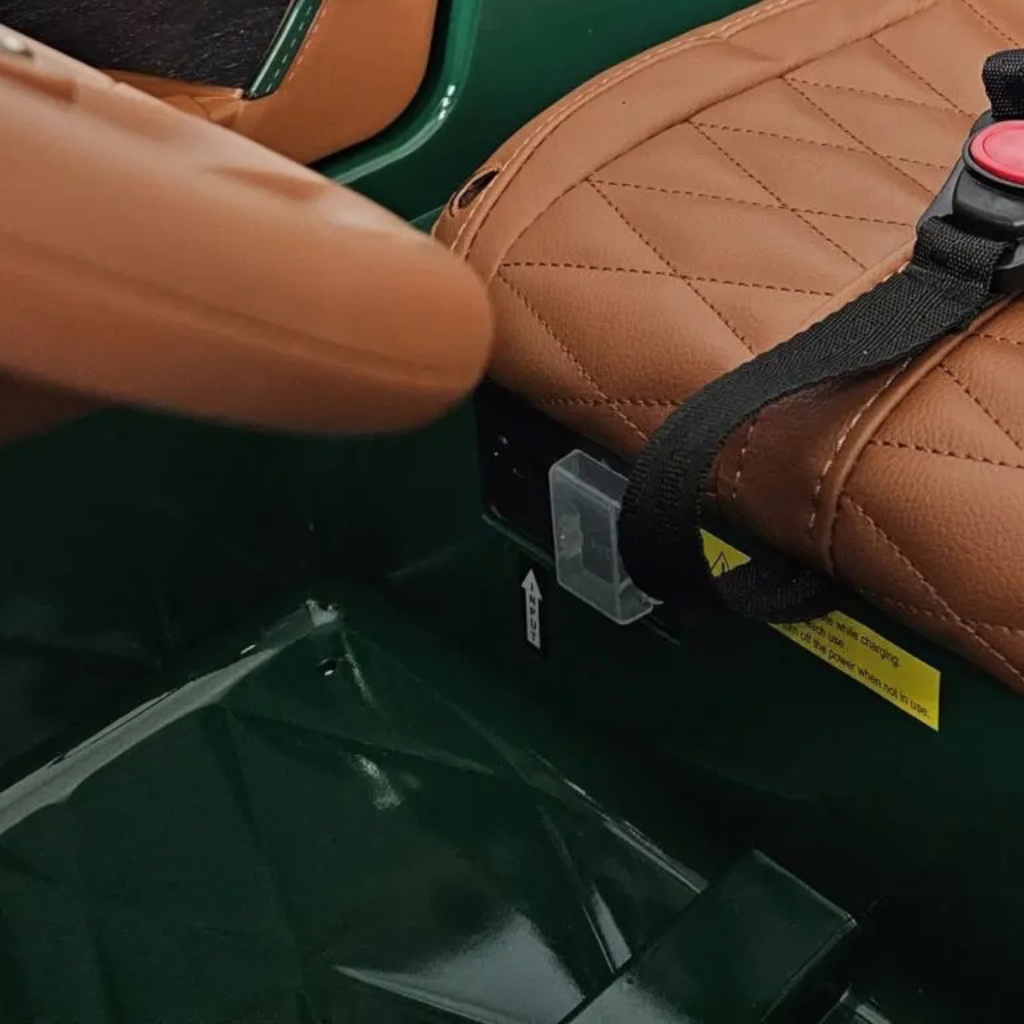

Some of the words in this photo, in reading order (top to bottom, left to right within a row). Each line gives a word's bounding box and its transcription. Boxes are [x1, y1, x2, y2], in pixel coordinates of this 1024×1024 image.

[528, 582, 537, 642] INPUT
[813, 638, 827, 654] the
[829, 649, 856, 671] power
[857, 666, 882, 689] when
[883, 682, 898, 700] not
[899, 689, 908, 706] in
